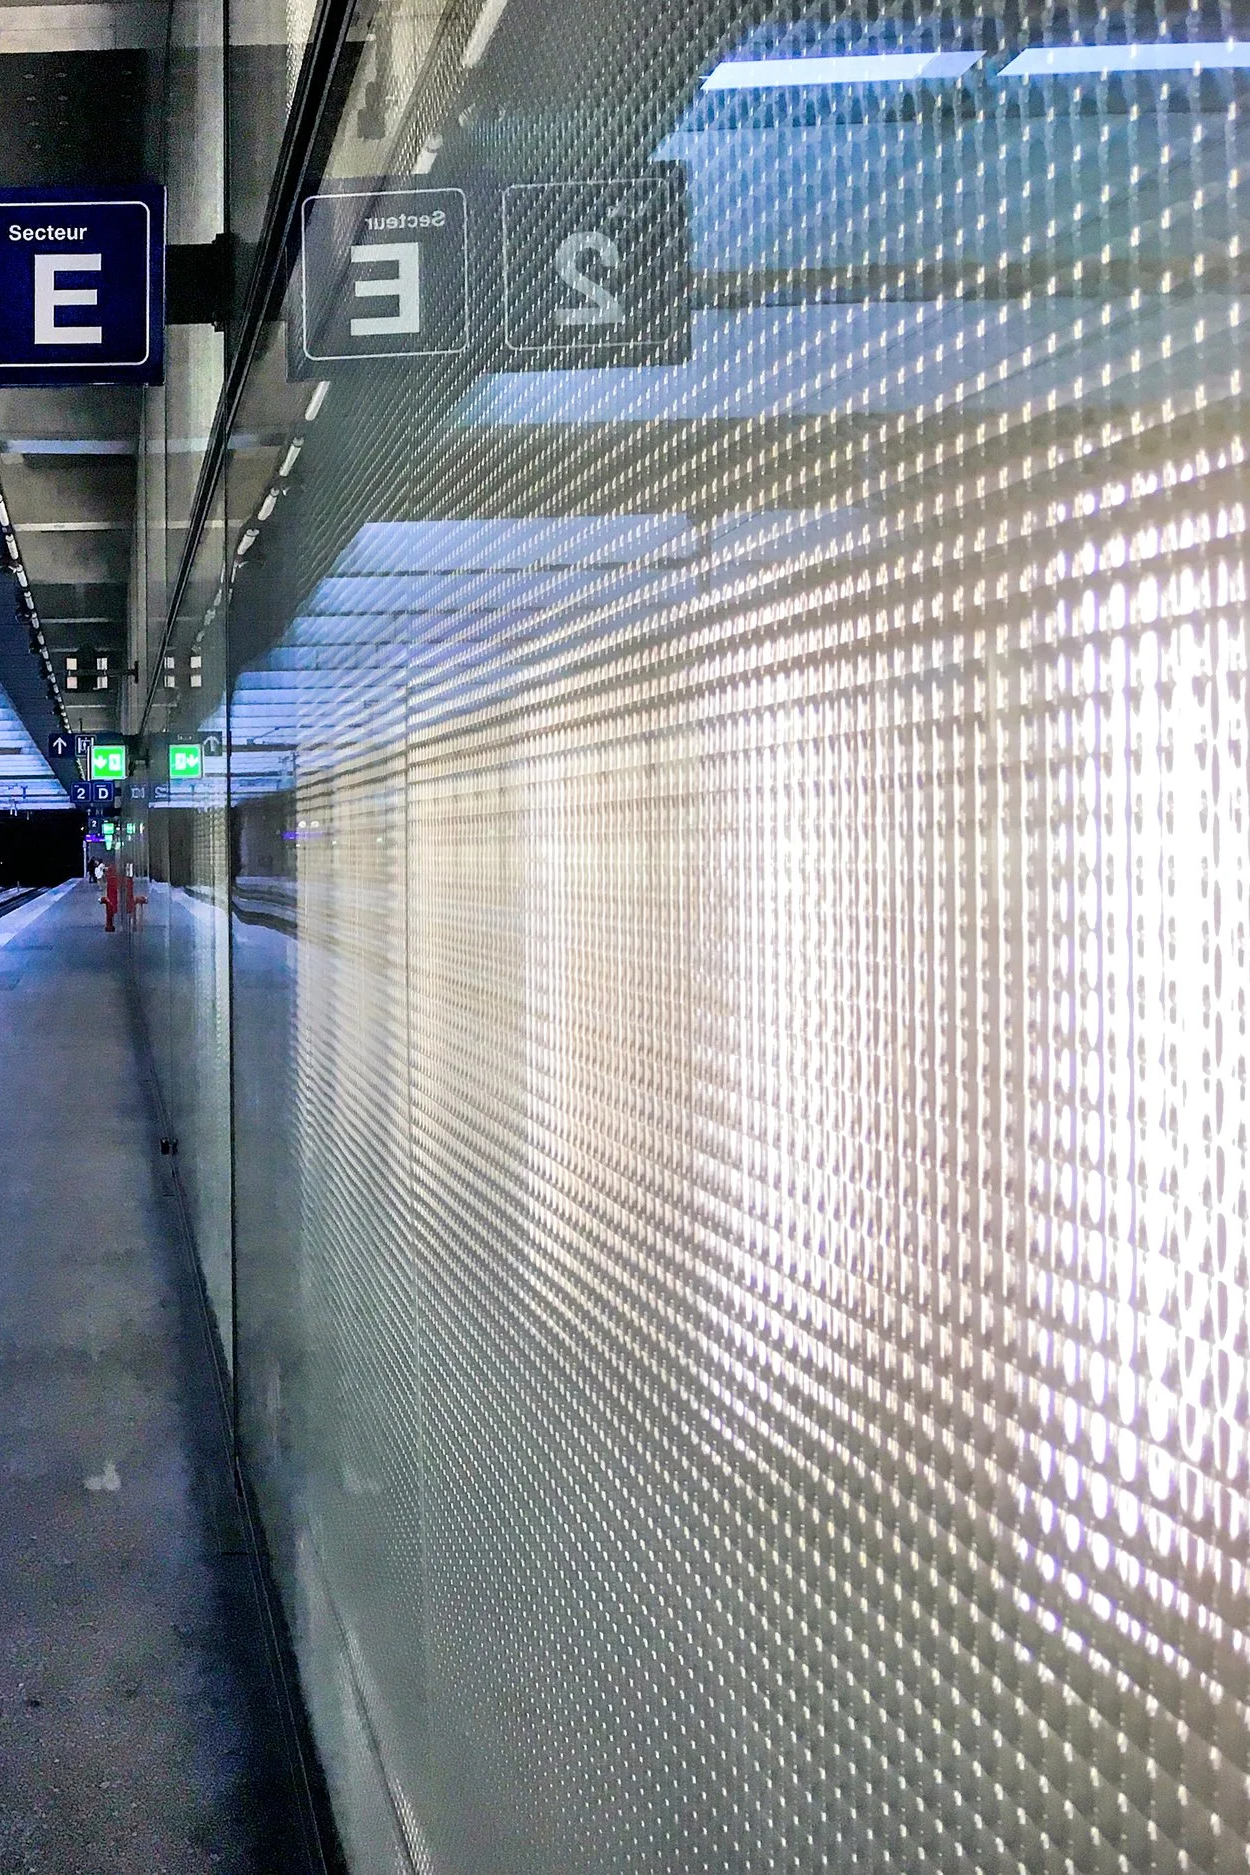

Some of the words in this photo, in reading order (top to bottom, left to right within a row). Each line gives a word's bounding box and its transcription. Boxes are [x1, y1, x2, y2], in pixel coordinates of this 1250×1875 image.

[8, 223, 88, 241] Secteur
[34, 253, 102, 345] E
[77, 787, 86, 800] 2
[98, 787, 109, 799] D
[91, 820, 97, 828] 2
